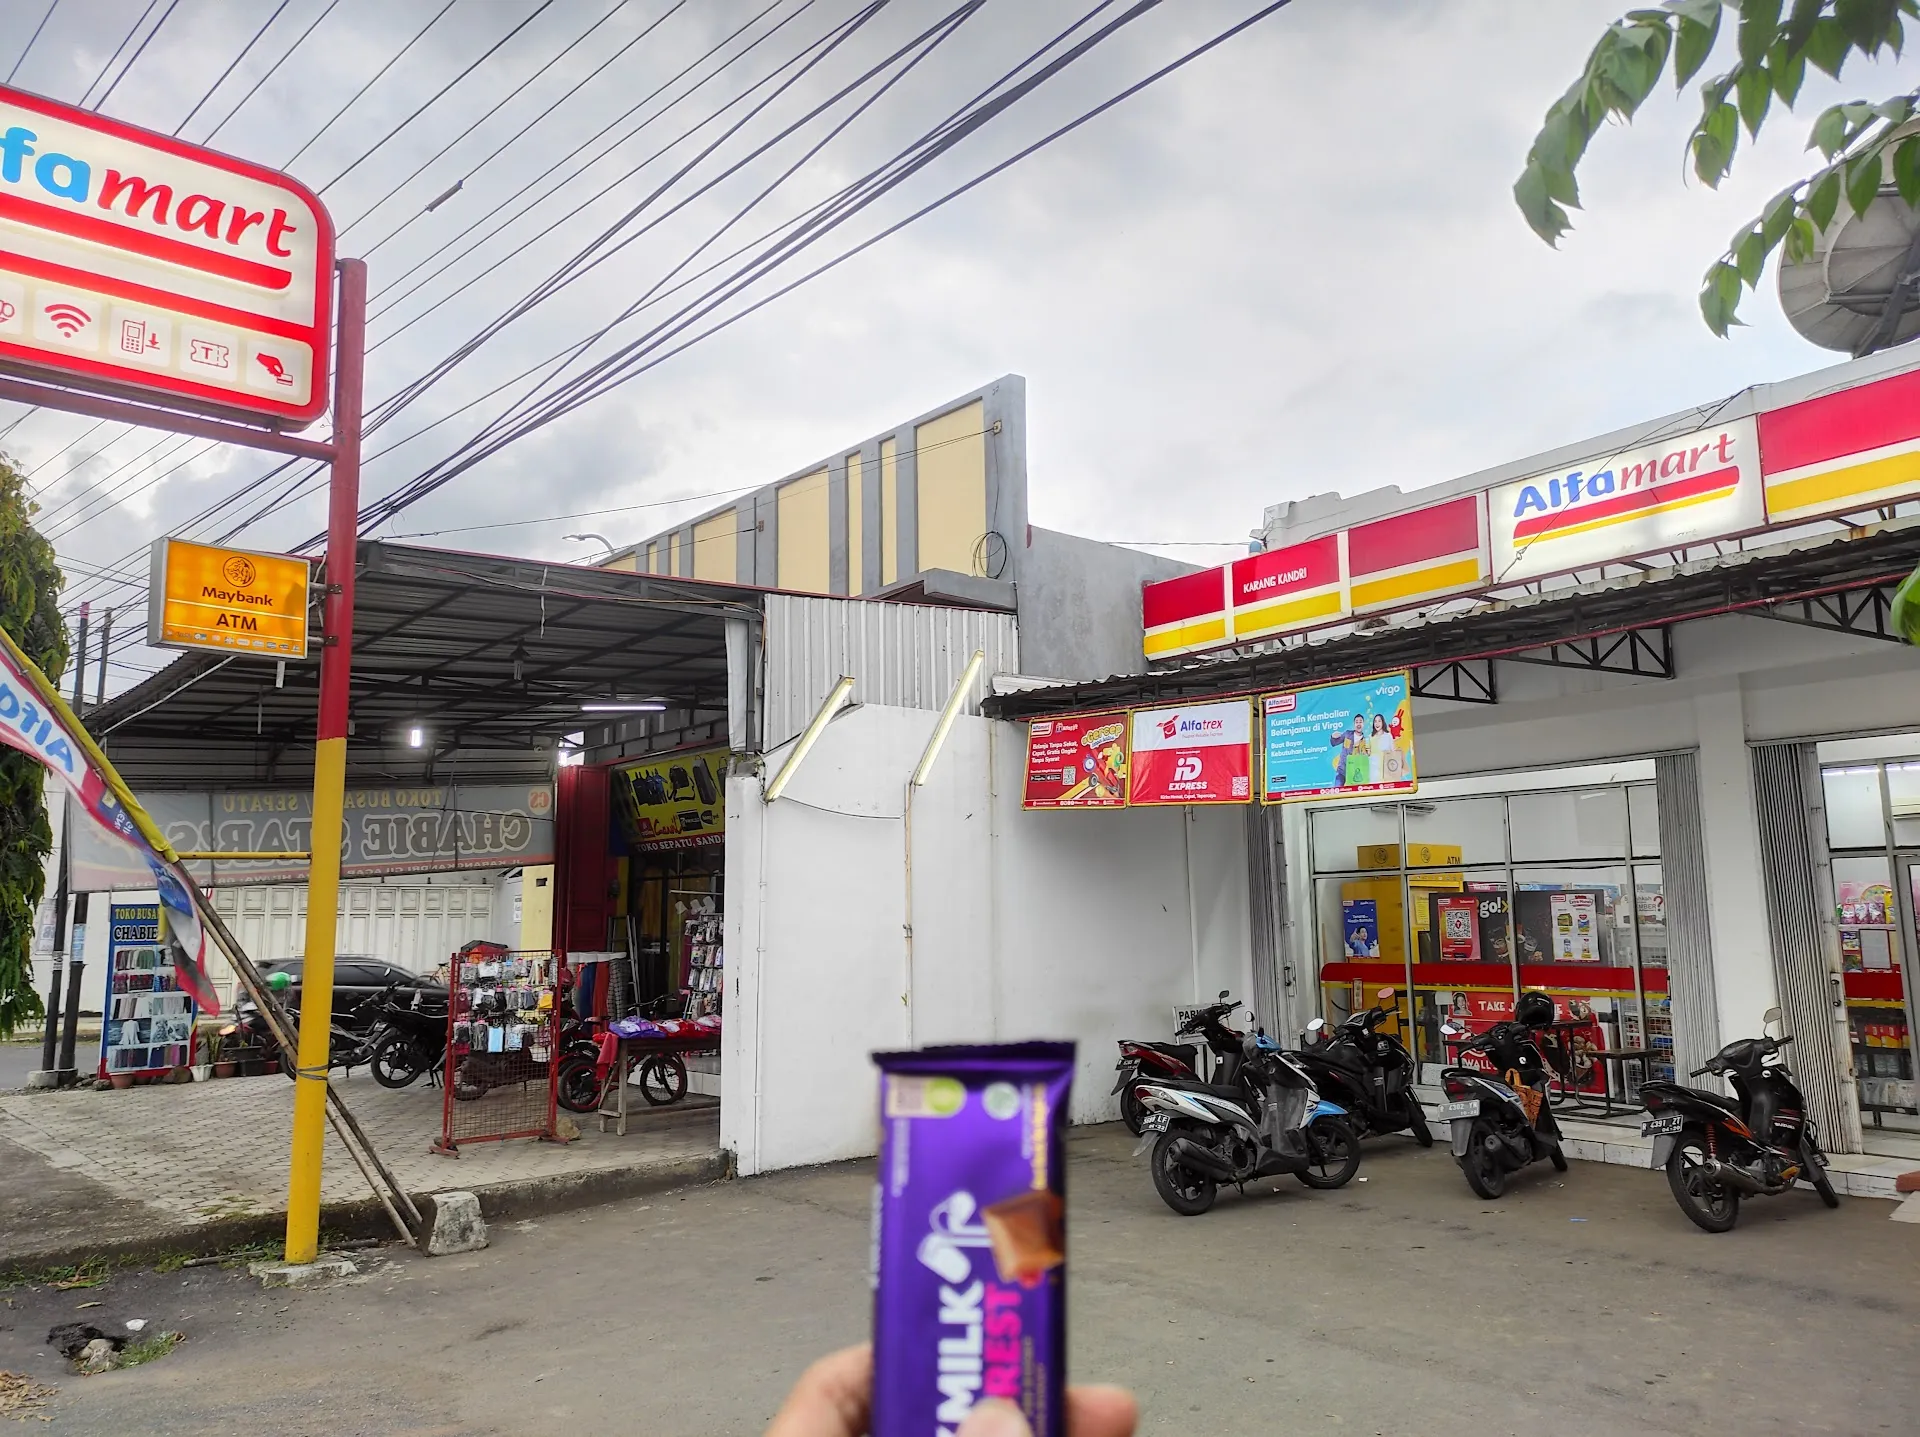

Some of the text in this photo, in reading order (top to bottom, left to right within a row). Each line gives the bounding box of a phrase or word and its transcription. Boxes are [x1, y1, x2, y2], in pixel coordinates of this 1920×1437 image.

[1513, 433, 1737, 517] Alfamart
[1243, 567, 1307, 594] KARANG KANDRI
[201, 586, 273, 606] Maybank
[216, 613, 258, 631] ATM
[1180, 719, 1223, 732] Alfatrex
[1270, 710, 1349, 727] Kumpulin Kembalian
[1270, 721, 1344, 737] Belanjamu di Virgo
[1270, 746, 1328, 757] Kebutuhan Lainnya
[1285, 740, 1303, 749] Bayar
[1168, 781, 1208, 791] EXPRESS
[659, 838, 696, 851] SEPATU,
[1446, 856, 1461, 865] ATM
[115, 908, 136, 920] TOKO
[1478, 1000, 1506, 1012] TAKE
[982, 1282, 1022, 1398] REST
[936, 1279, 985, 1424] MILK
